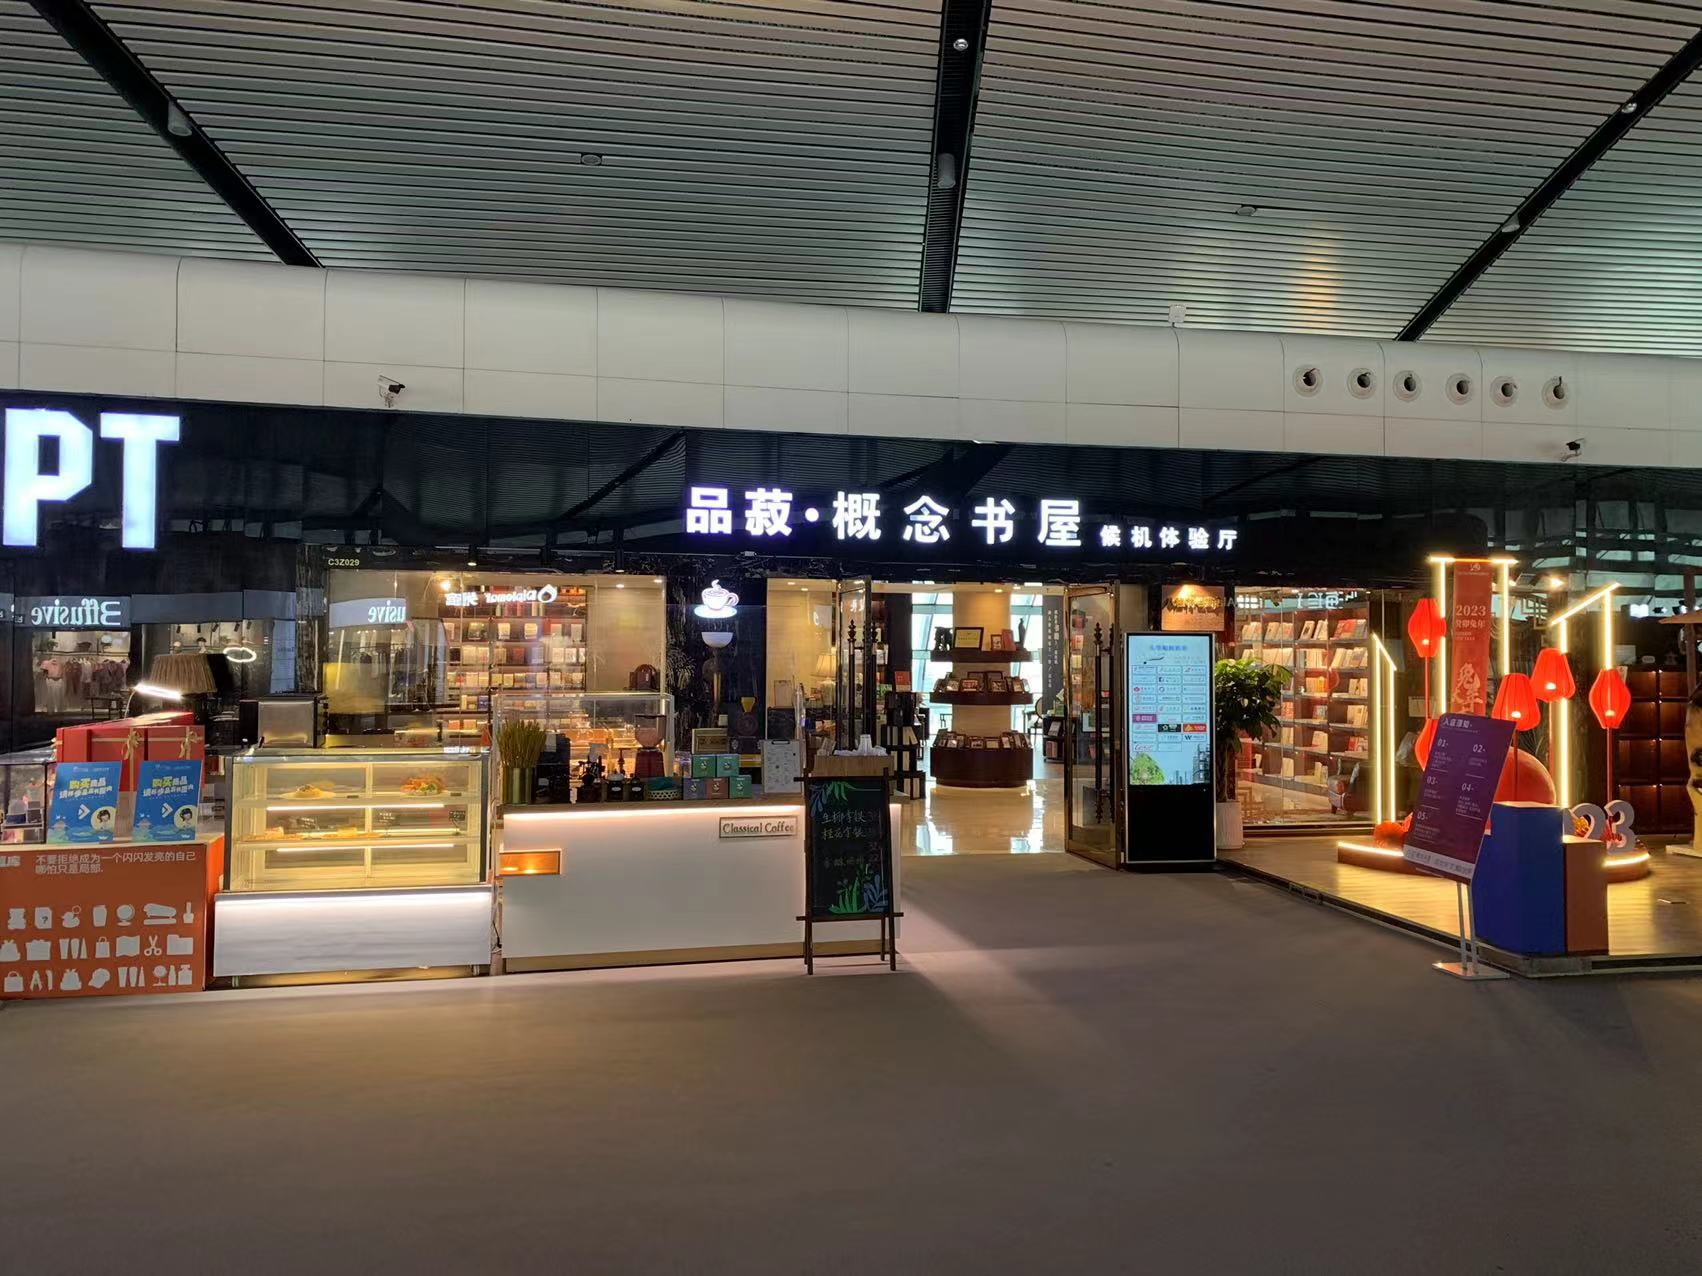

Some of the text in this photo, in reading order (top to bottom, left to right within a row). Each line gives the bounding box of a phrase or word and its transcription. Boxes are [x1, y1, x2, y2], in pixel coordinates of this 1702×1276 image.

[2, 407, 181, 549] PT
[1099, 524, 1239, 551] 候机体验厅
[327, 558, 360, 567] C3Z029
[1455, 605, 1487, 617] 2023
[722, 820, 794, 834] Classical Coffee
[36, 851, 197, 864] 不要拒绝成为一个闪闪发亮的自己
